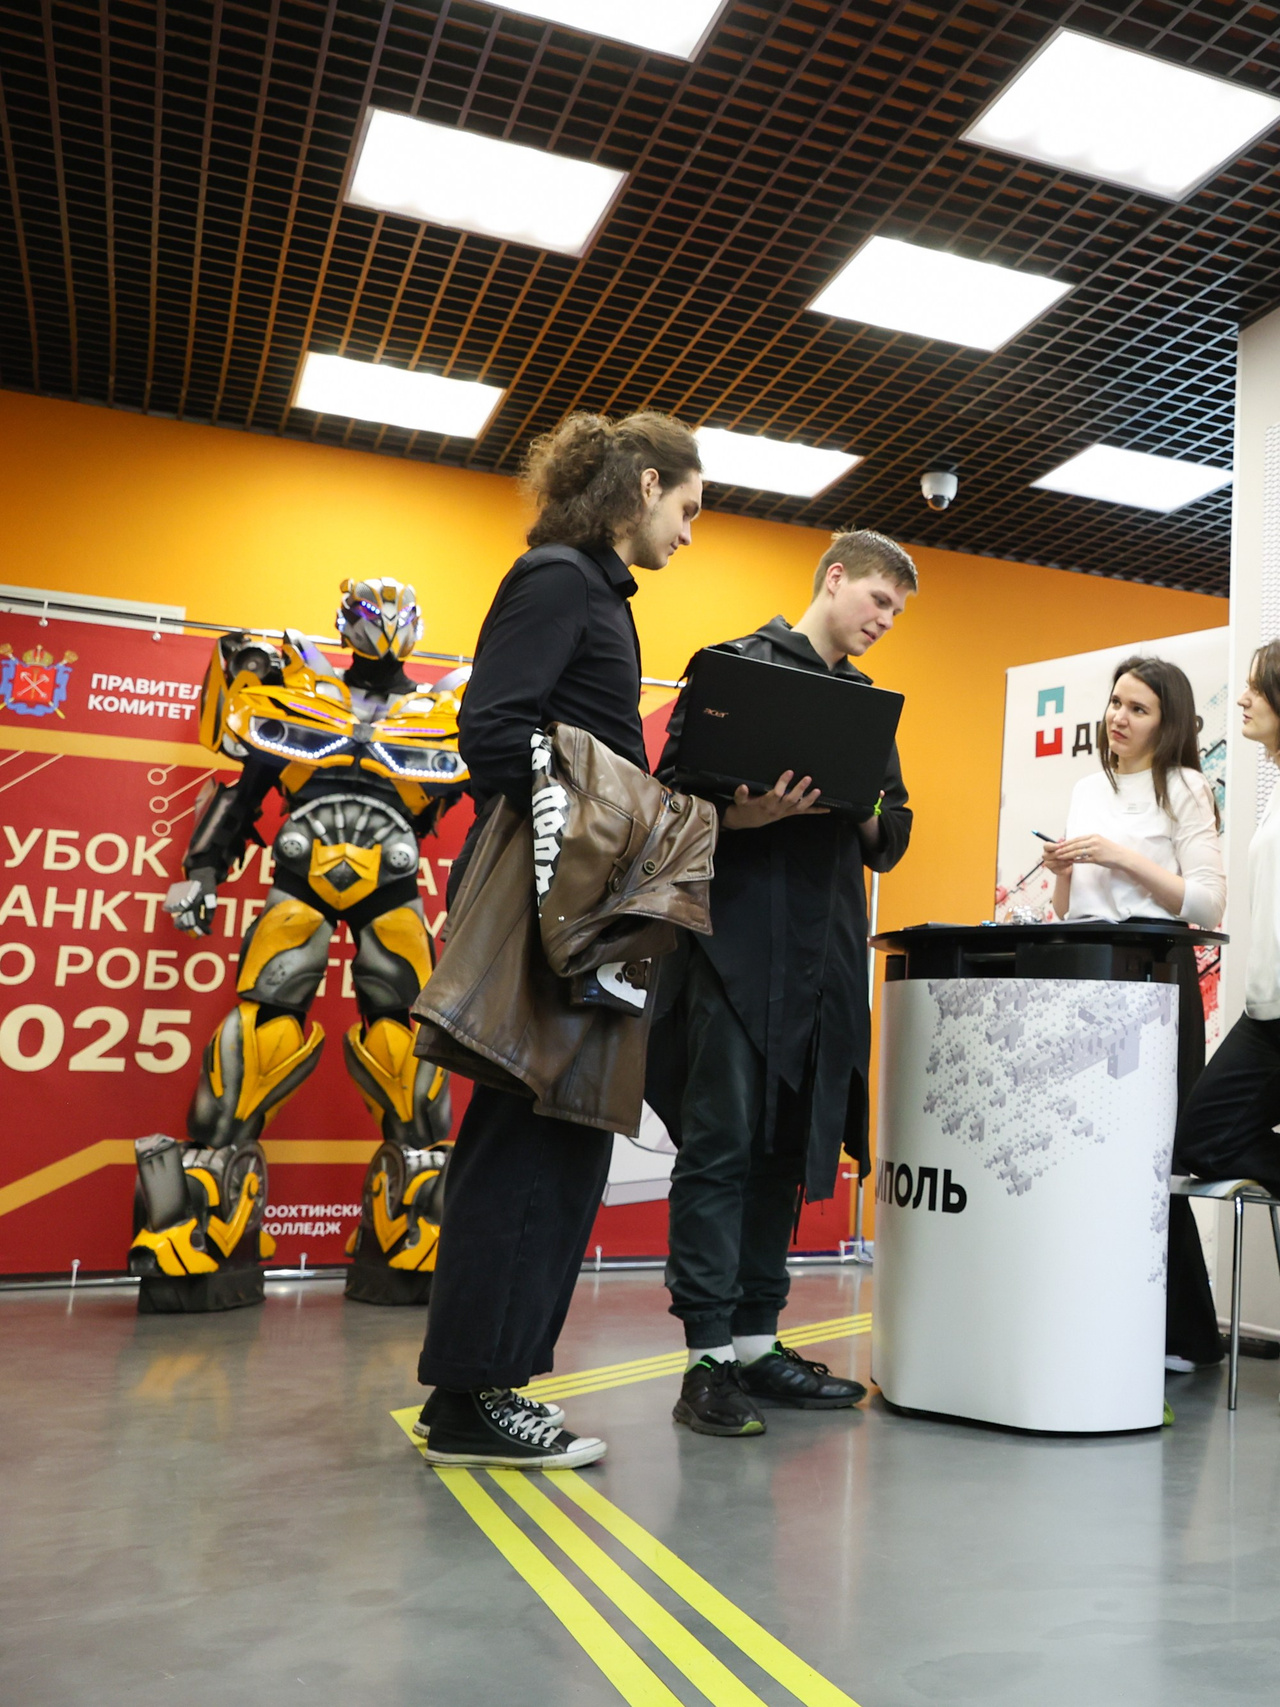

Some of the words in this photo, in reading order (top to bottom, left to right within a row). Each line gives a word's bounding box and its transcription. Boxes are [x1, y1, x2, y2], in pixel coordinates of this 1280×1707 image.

[88, 694, 196, 720] КОМИТЕТ
[3, 825, 173, 878] УБОК
[875, 1158, 967, 1214] ИПОЛЬ
